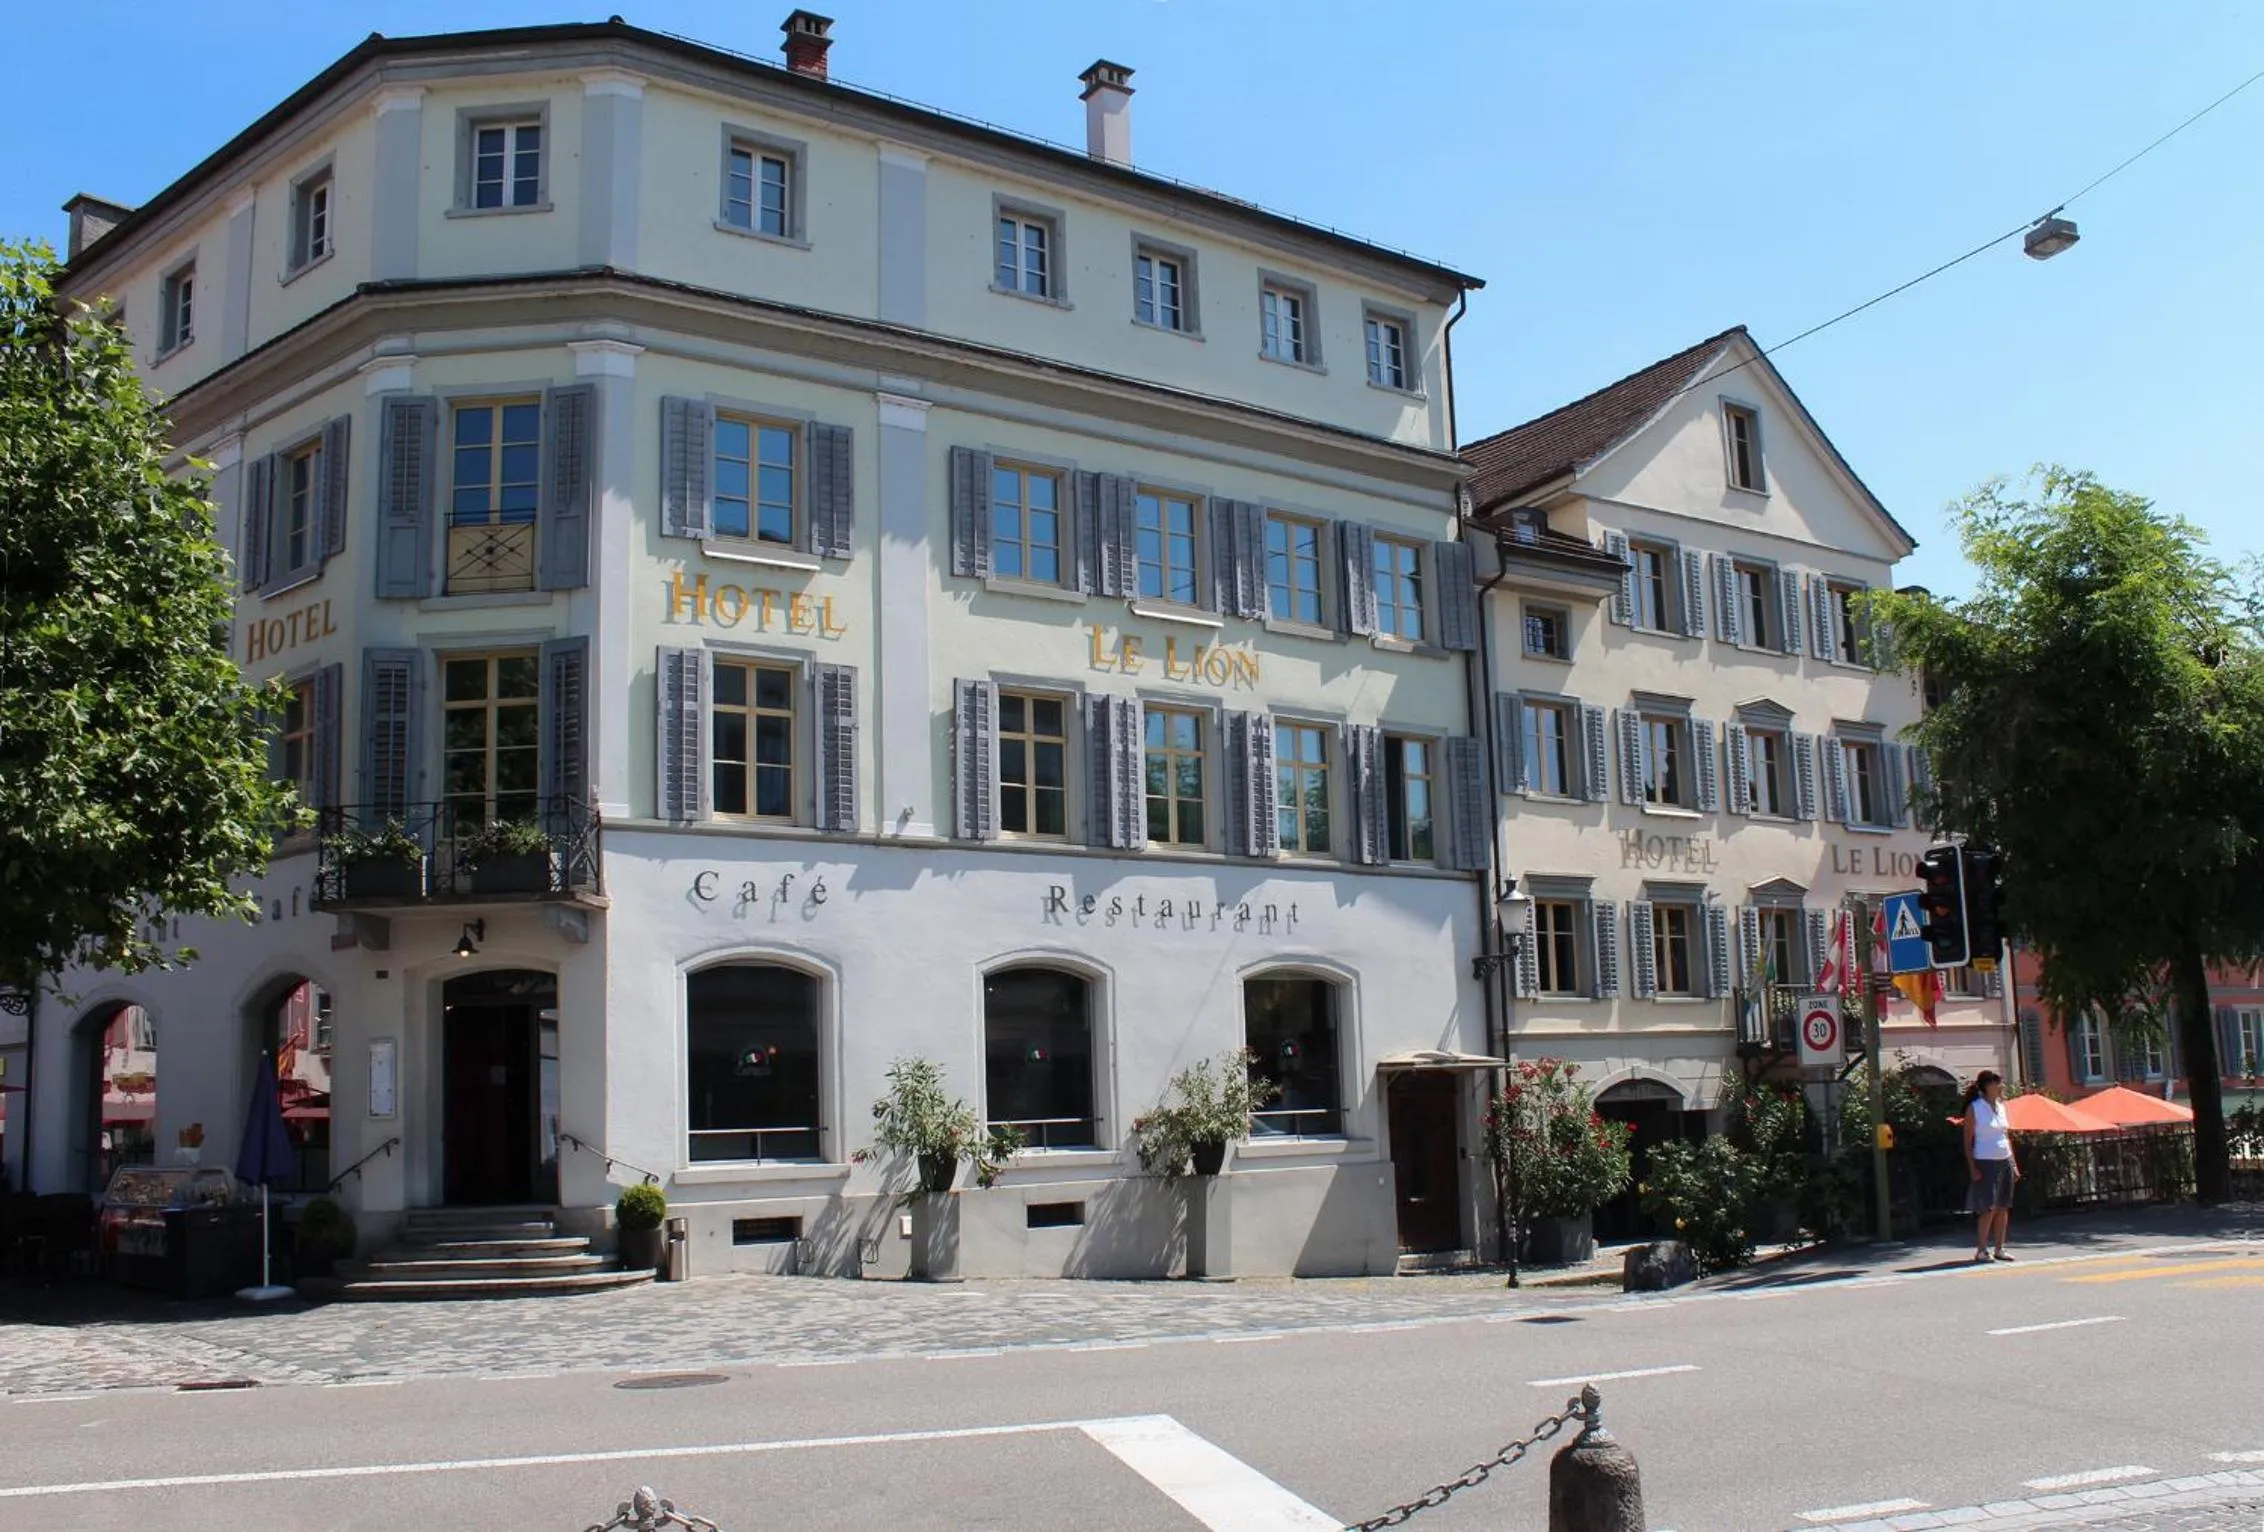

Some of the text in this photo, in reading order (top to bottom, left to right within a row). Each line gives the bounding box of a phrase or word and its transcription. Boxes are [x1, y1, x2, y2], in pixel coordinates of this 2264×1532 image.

[671, 570, 848, 634] HOTEL
[246, 598, 337, 665] HOTEL
[1091, 624, 1260, 684] LE LION
[1618, 828, 1719, 866] HOTEL
[1832, 844, 1862, 875] LE
[693, 870, 828, 905] Café
[1049, 885, 1300, 924] Restaurant
[1812, 1022, 1828, 1040] 30
